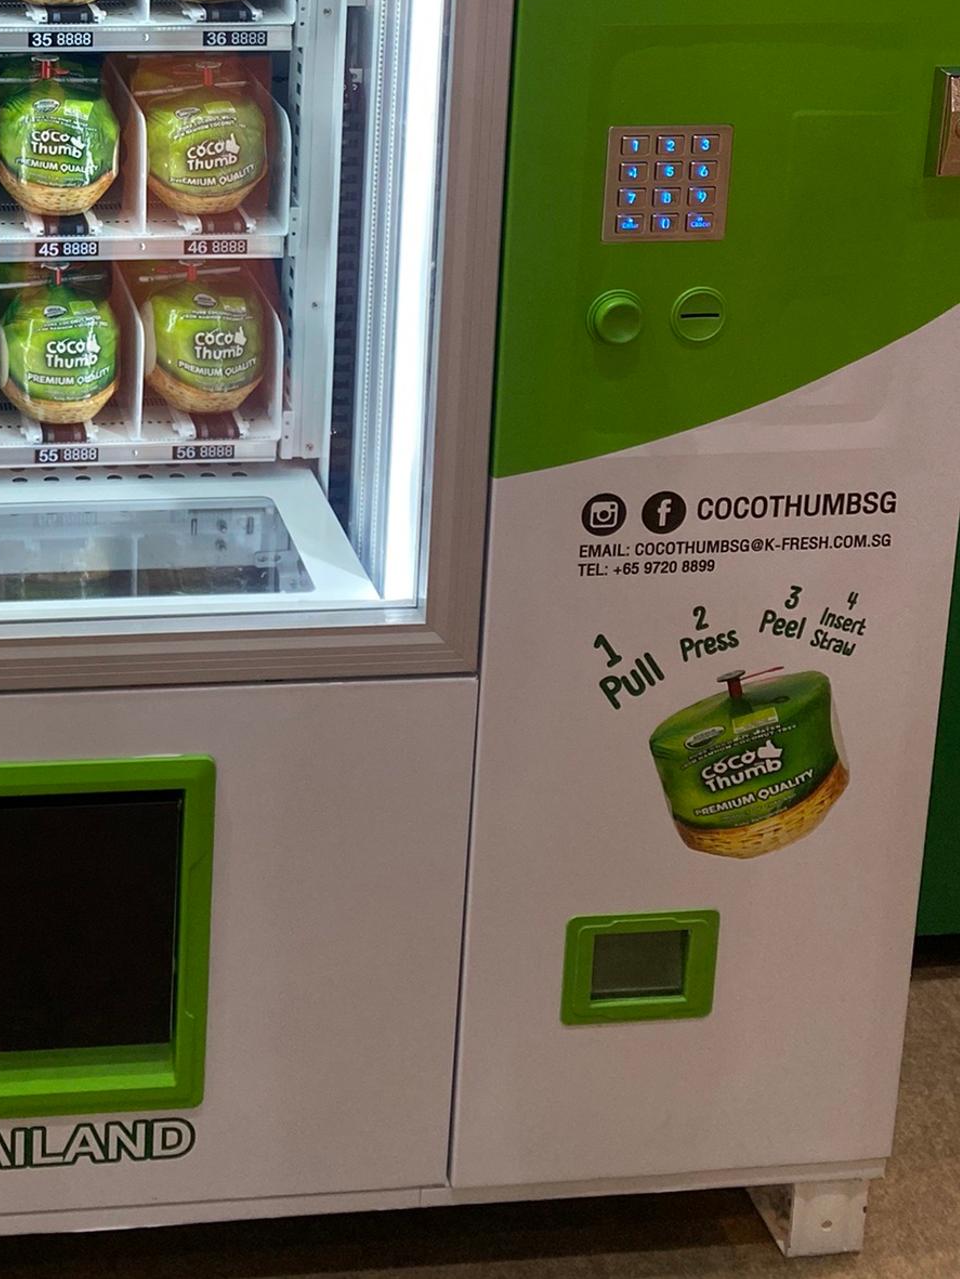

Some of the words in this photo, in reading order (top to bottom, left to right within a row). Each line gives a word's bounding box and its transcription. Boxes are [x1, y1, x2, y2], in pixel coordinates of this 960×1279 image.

[39, 242, 59, 256] 45
[194, 344, 244, 361] Thumb
[177, 360, 223, 377] PREMIUM
[225, 357, 257, 377] QUALITY
[697, 491, 897, 521] COCOTHUMBSG
[579, 543, 630, 558] EMAIL:
[634, 534, 892, 557] COCOTHUMBSG@K-FRESH.COM.SG
[578, 564, 609, 577] TEL:
[613, 562, 640, 576] +65
[644, 560, 678, 575] 9720
[681, 559, 715, 573] 8899
[784, 585, 802, 609] 3
[847, 591, 859, 610] 4
[693, 606, 709, 631] 2
[759, 609, 807, 639] Peel
[819, 607, 867, 636] Insert
[593, 633, 622, 668] 1
[680, 630, 740, 662] Press
[810, 629, 857, 657] Straw
[599, 652, 665, 710] Pull
[705, 758, 783, 793] Thumb
[695, 794, 755, 816] PREMIUM
[757, 769, 815, 801] QUALITY
